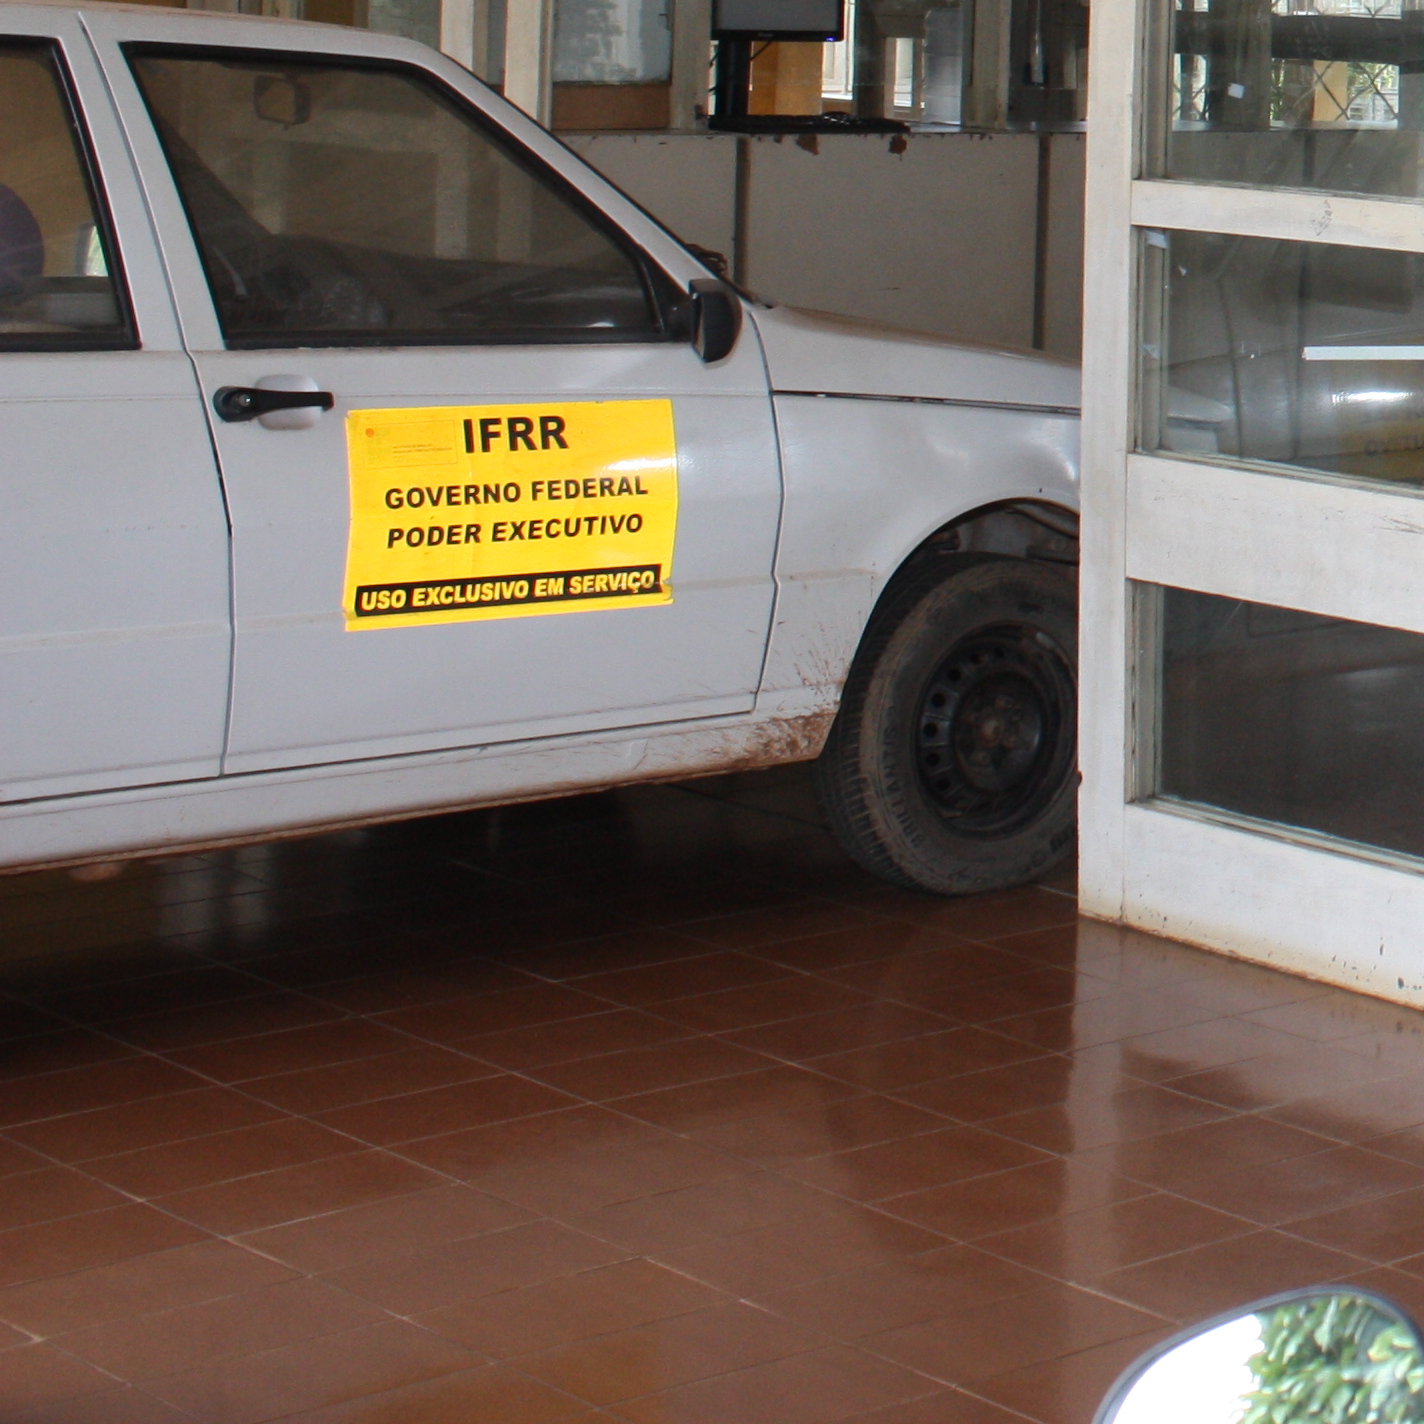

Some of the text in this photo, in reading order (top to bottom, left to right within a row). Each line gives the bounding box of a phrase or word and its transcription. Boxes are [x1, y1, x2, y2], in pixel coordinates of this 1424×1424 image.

[463, 416, 568, 453] IFRR
[385, 476, 649, 510] GOVERNO FEDERAL
[387, 513, 643, 549] PODER EXECUTIVO
[361, 570, 655, 611] USO EXCLUSIVO EM SERVIÇO
